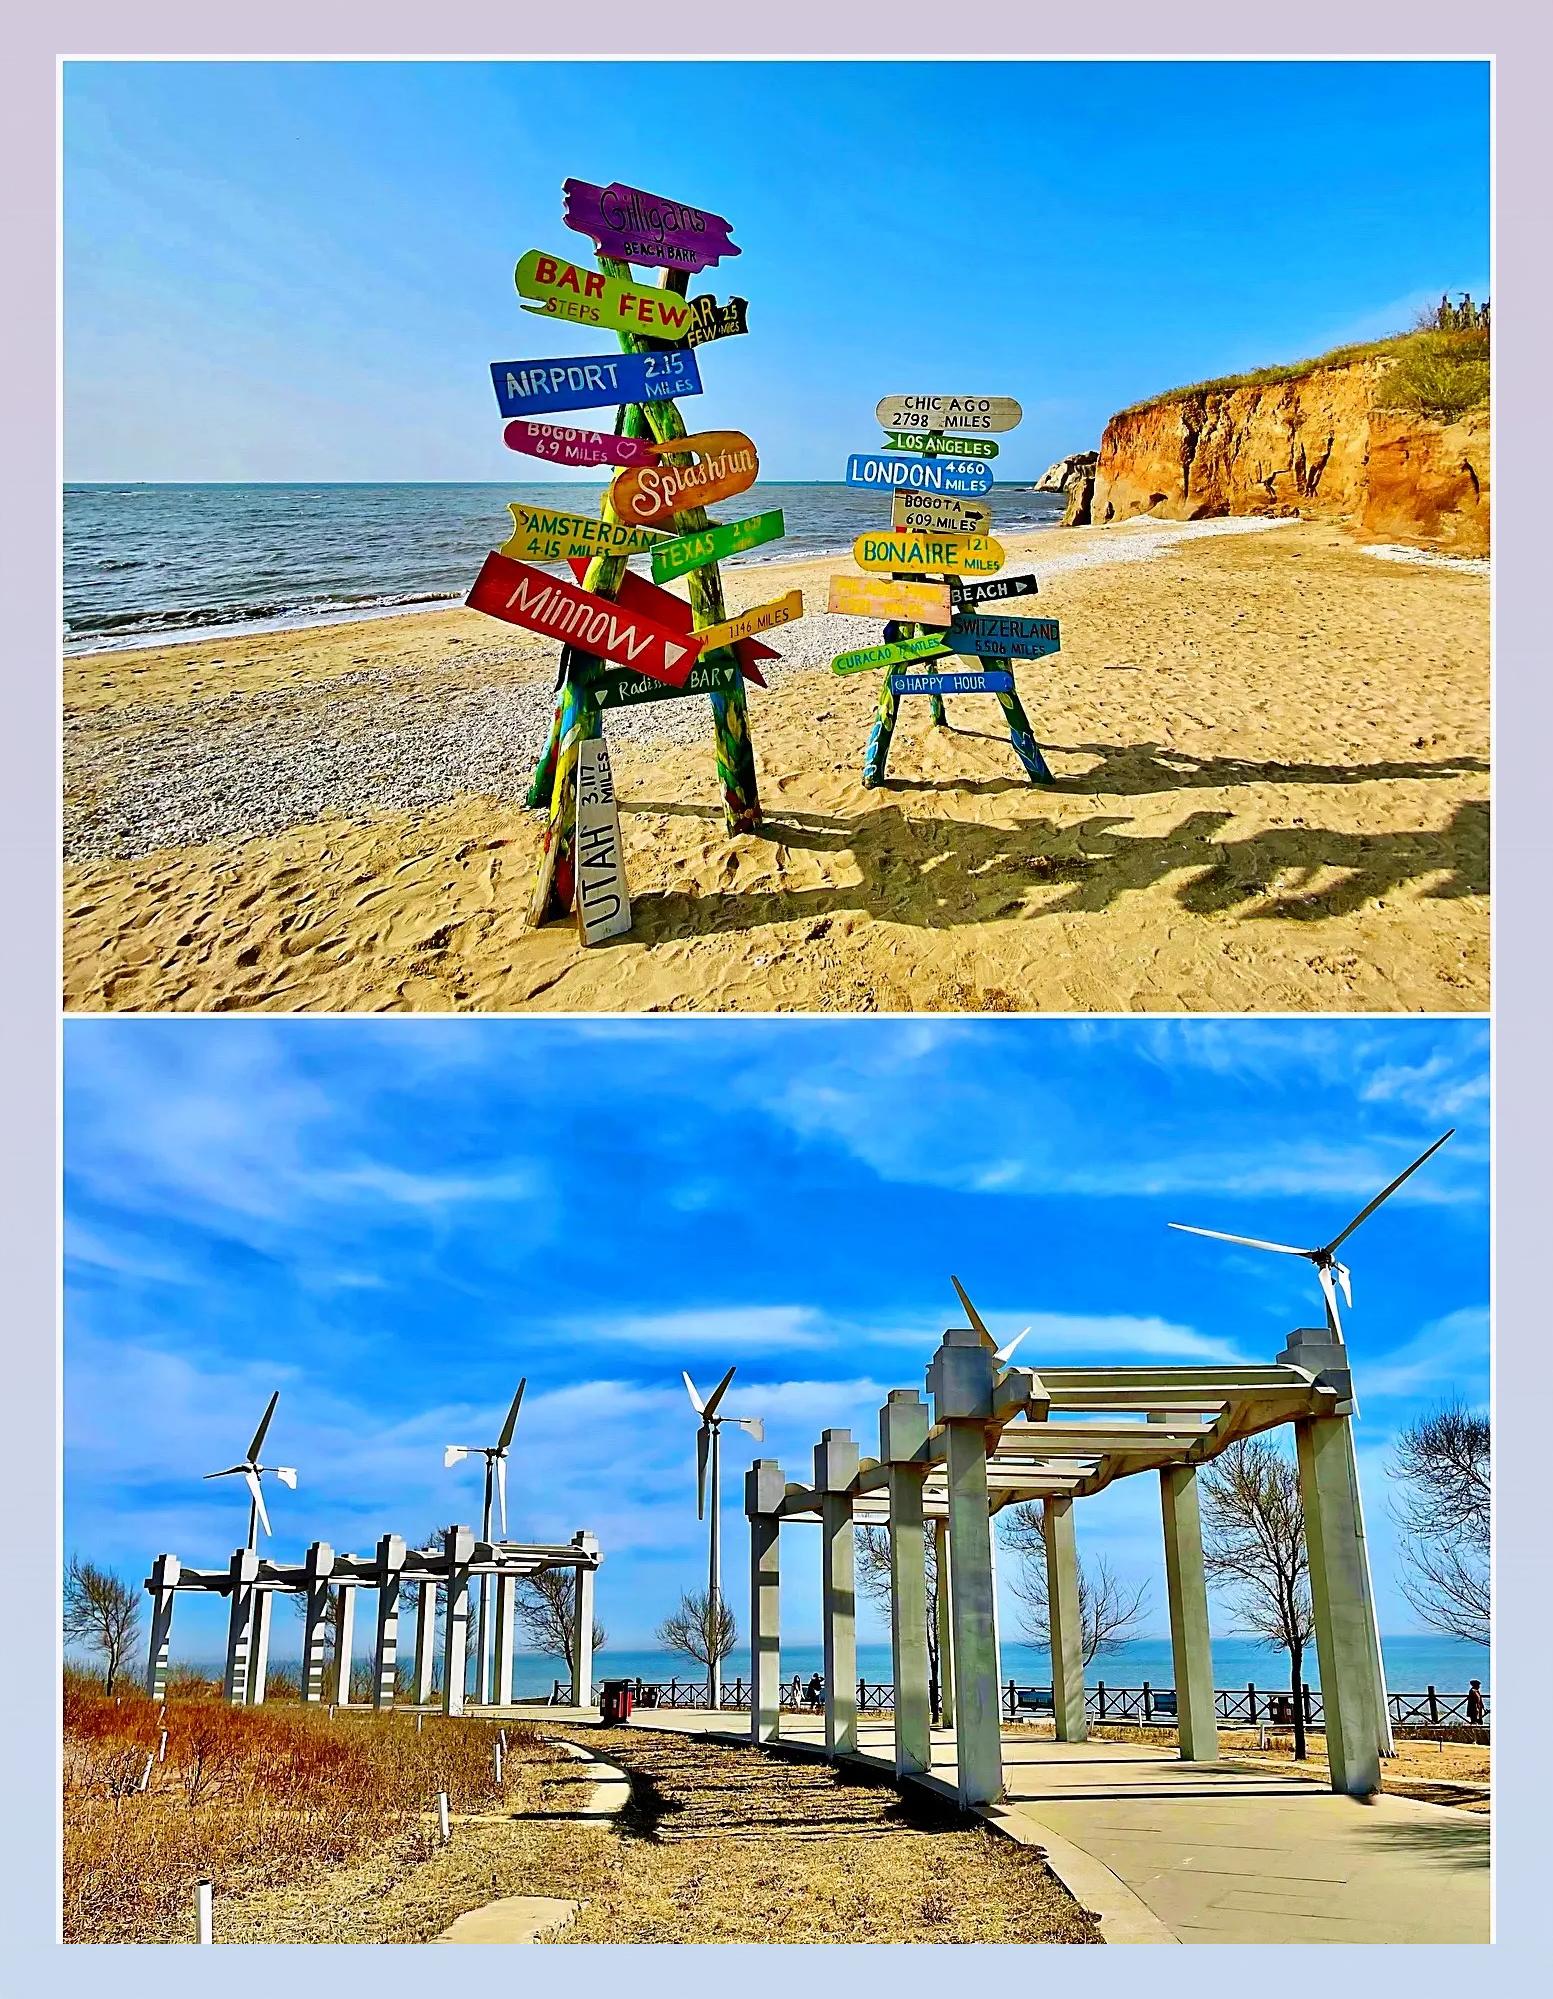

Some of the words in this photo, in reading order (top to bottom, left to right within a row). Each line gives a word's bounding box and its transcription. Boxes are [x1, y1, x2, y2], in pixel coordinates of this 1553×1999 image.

[601, 190, 707, 242] Gilligans
[623, 241, 664, 257] BEACH
[667, 246, 697, 263] BARR
[535, 257, 607, 299] BAR
[619, 292, 688, 328] FEW
[547, 297, 600, 322] STEPS
[688, 325, 717, 349] FEW
[507, 363, 618, 399] AIRPORT
[644, 353, 684, 378] 2.15
[644, 378, 694, 397] MILES
[892, 412, 929, 427] 2798
[944, 415, 991, 428] MILES
[527, 423, 603, 445] BOGOTA
[897, 434, 923, 450] LOS
[925, 437, 992, 456] ANGELES
[536, 439, 559, 456] 6.9
[565, 445, 608, 463] MILES
[631, 448, 755, 517] Splashfun
[852, 459, 942, 489] LONDON
[945, 479, 987, 492] MILES
[905, 494, 961, 512] BOGOTA
[526, 513, 656, 547] AMSTERDAM
[527, 537, 560, 559] 4.15
[659, 533, 714, 570] TEXAS
[863, 540, 959, 564] BONAIRE
[964, 557, 1000, 571] MILES
[951, 582, 1007, 603] BEACH
[729, 620, 752, 639] 1146
[757, 607, 789, 629] MILES
[953, 618, 1059, 640] SWITZERLAND
[836, 648, 892, 670] CURACAO
[690, 668, 721, 688] BAR
[907, 677, 944, 691] HAPPY
[953, 676, 985, 690] HOUR
[596, 751, 614, 804] MILES
[580, 824, 621, 928] UTAH
